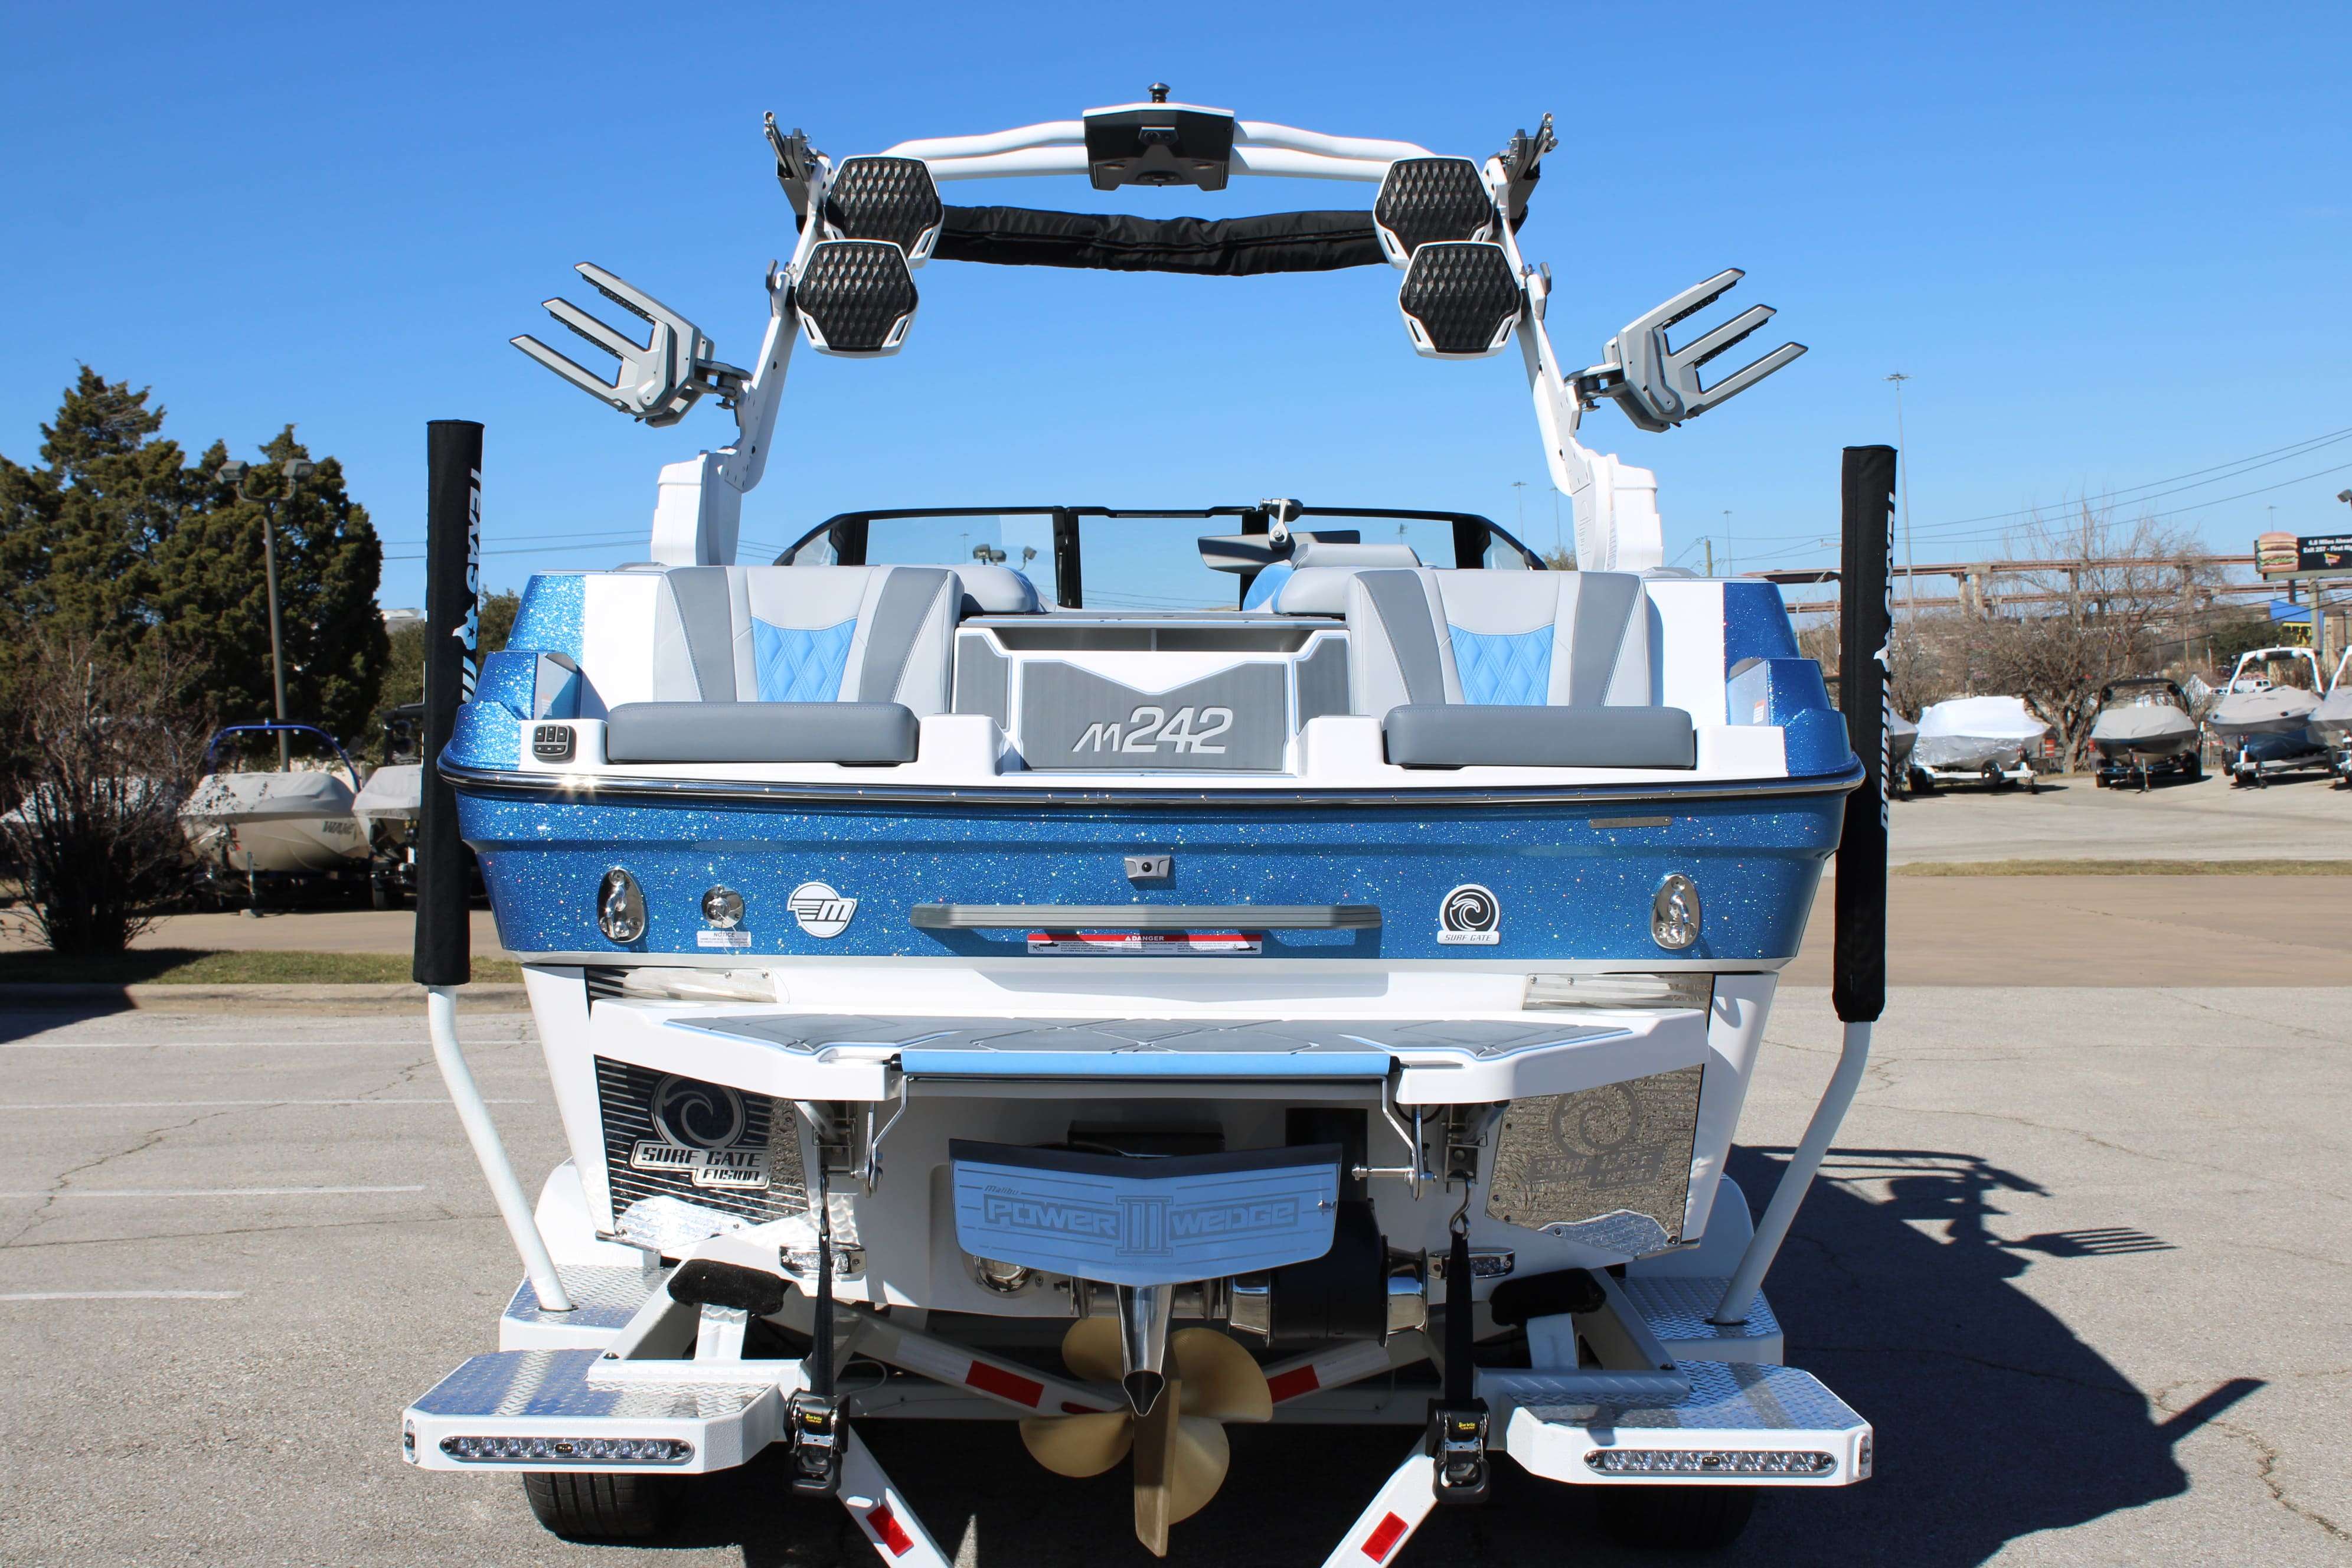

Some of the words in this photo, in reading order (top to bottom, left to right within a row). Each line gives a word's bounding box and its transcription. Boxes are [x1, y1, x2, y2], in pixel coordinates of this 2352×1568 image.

[642, 1147, 701, 1164] SURF
[706, 1151, 763, 1167] GATE
[703, 1168, 760, 1181] FUSION
[984, 1185, 1020, 1195] Malibu
